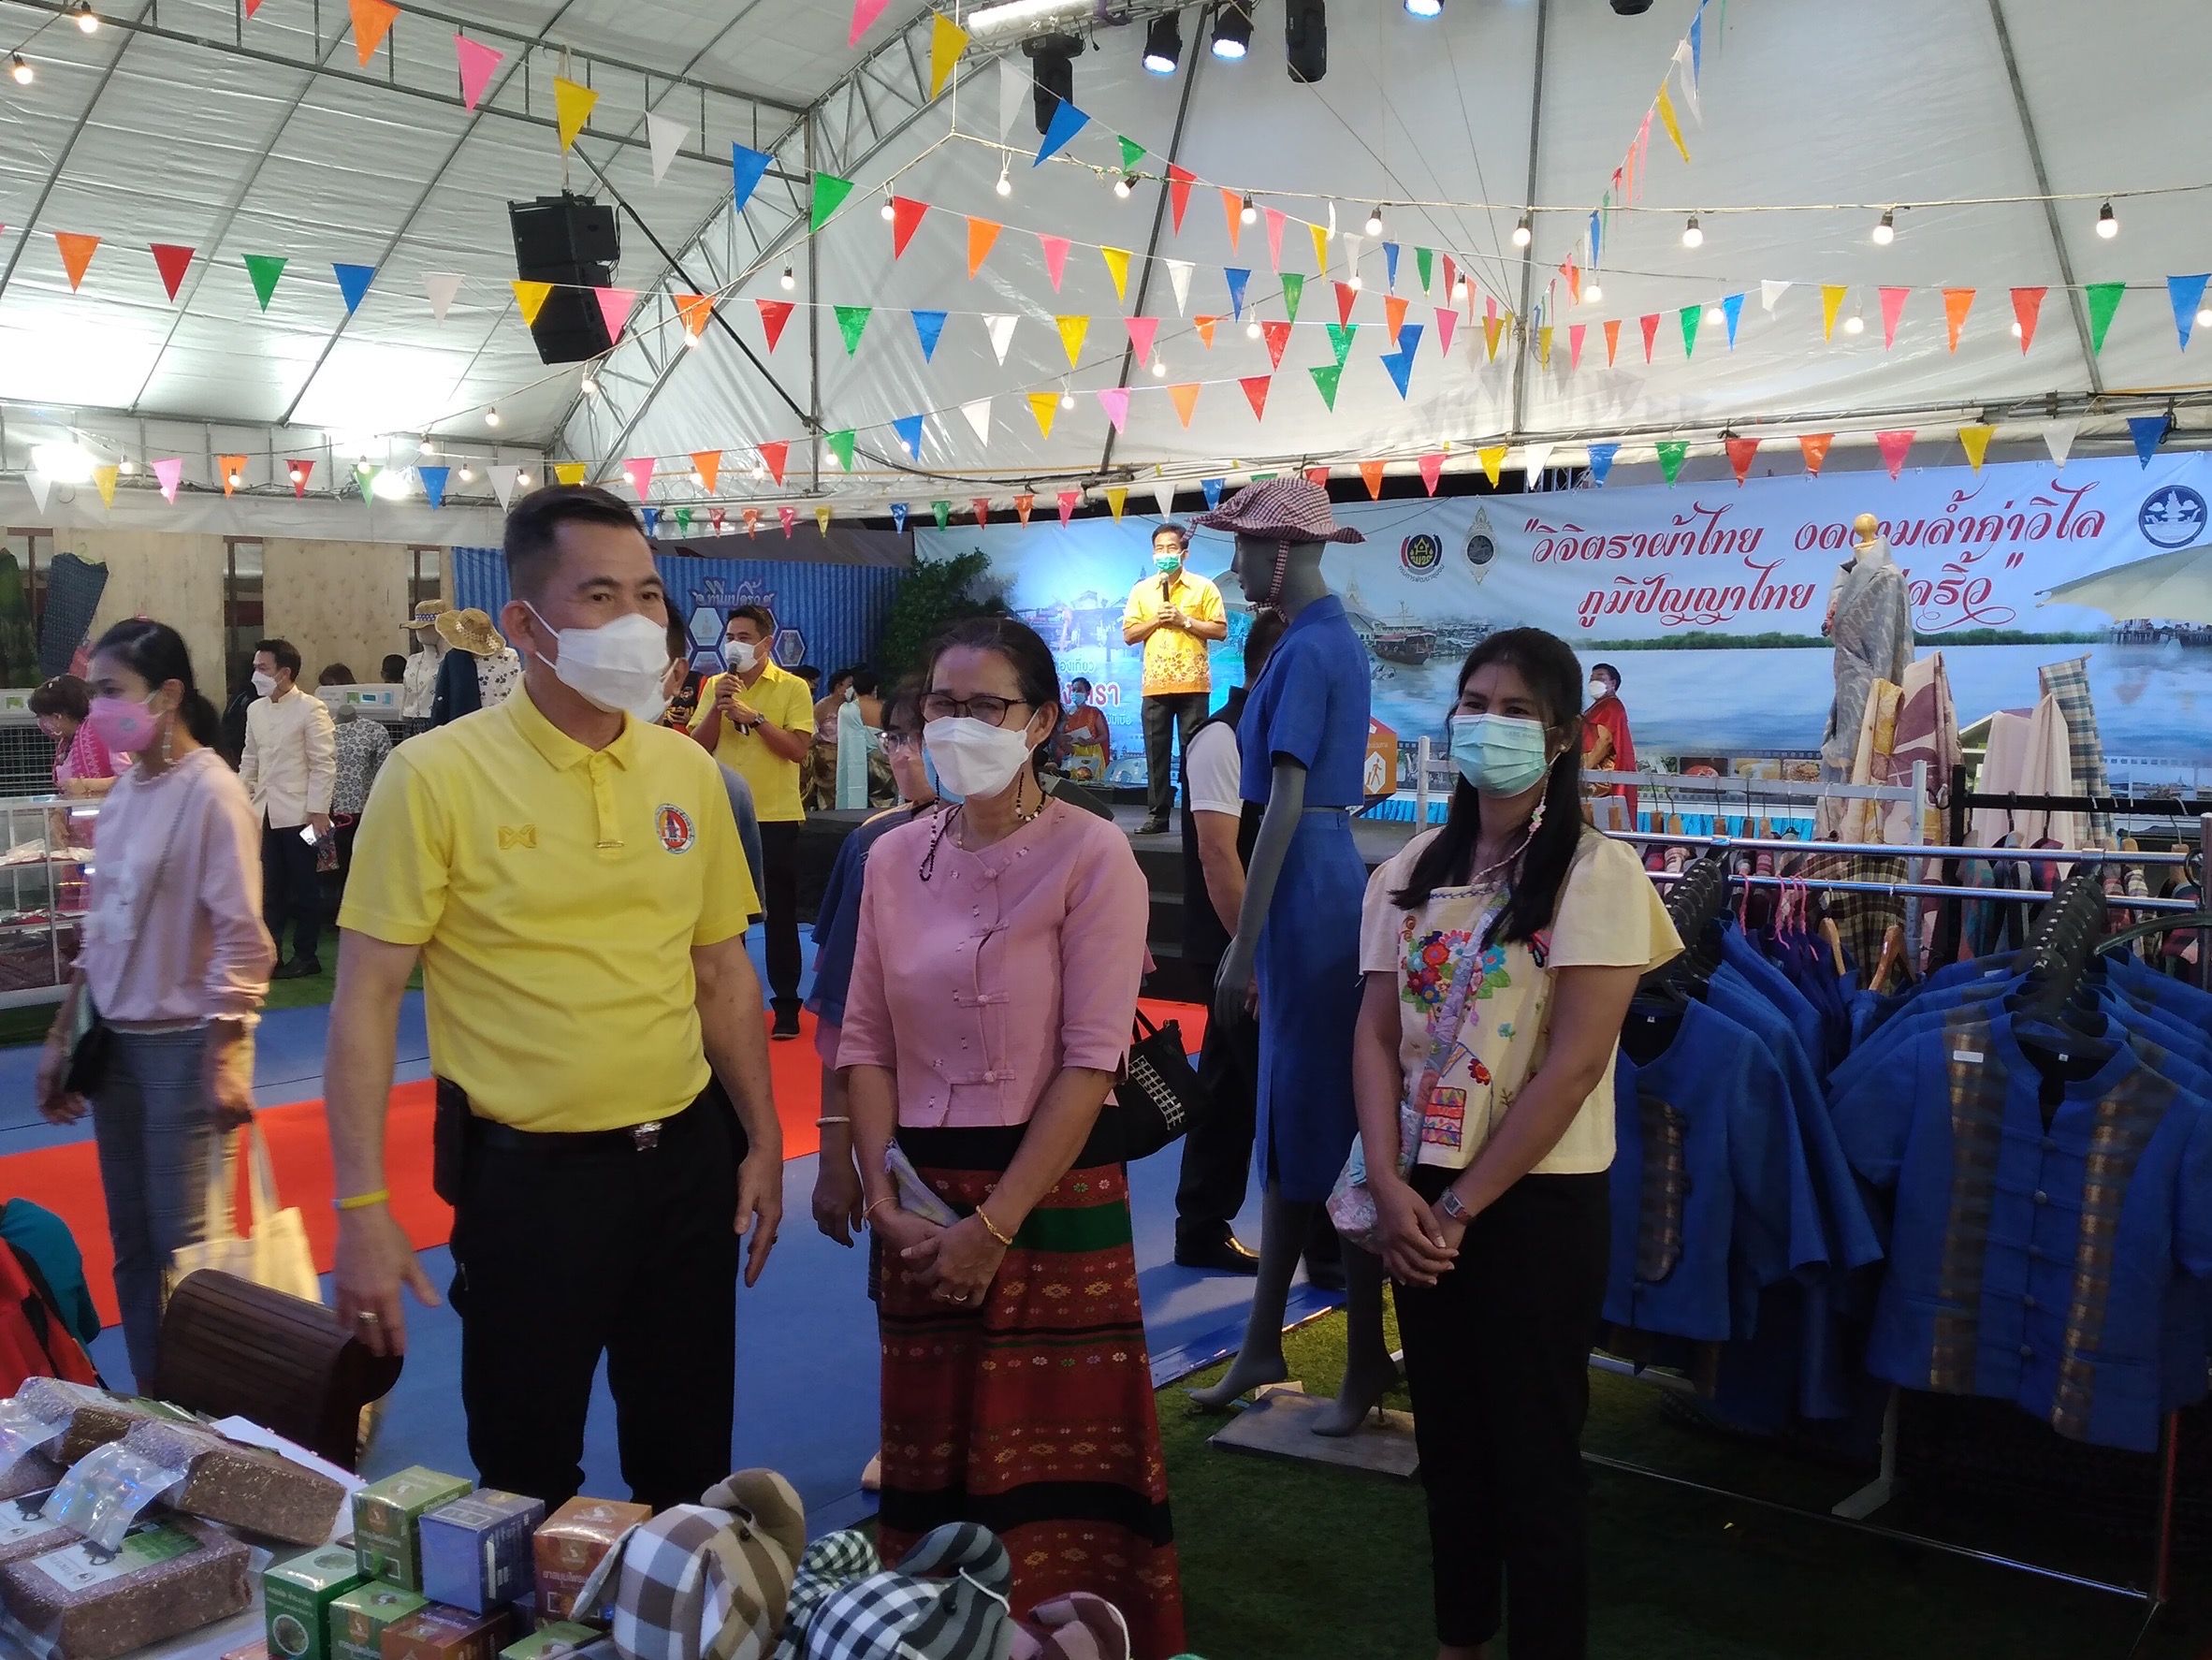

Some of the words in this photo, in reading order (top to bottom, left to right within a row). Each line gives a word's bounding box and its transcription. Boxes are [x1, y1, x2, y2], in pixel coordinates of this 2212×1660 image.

[1794, 474, 2106, 551] งดามล้ำค่าวิไล
[1578, 555, 1817, 629] ภูมิปัญญาไทย
